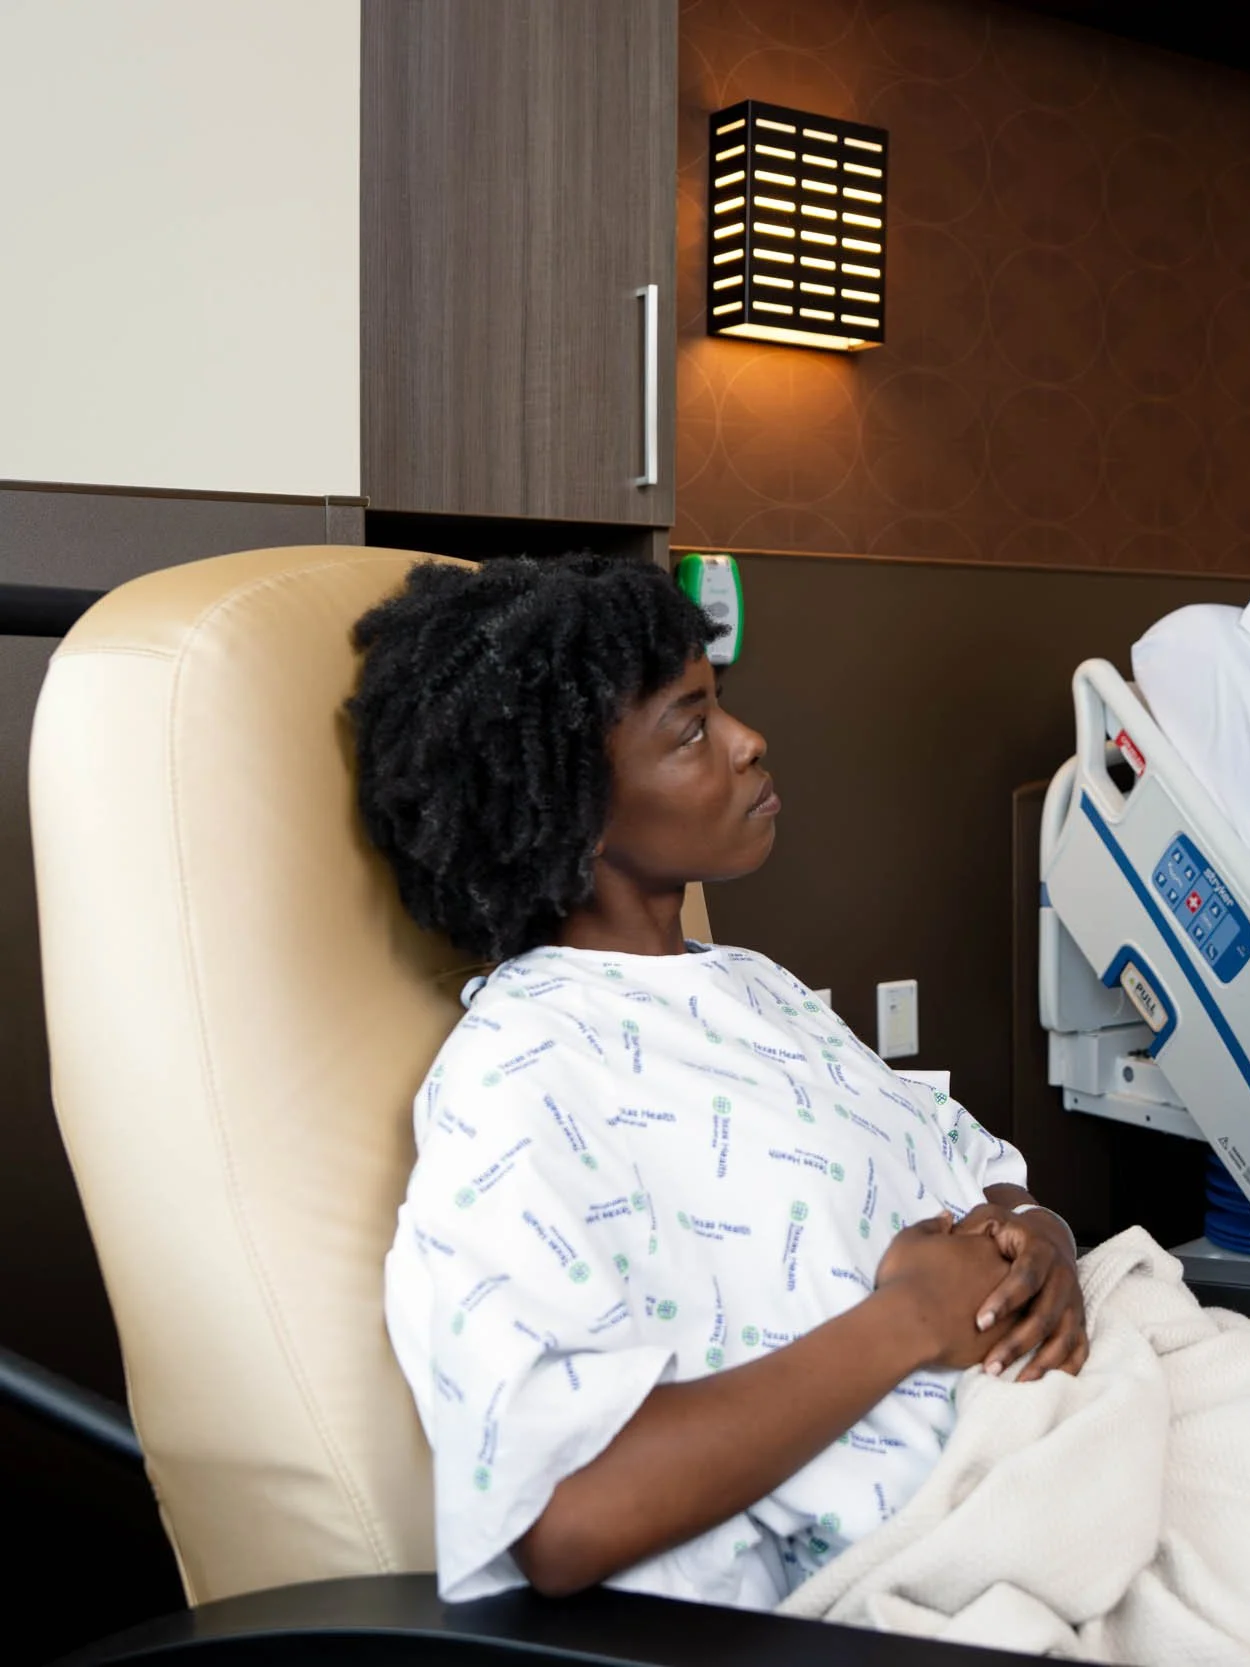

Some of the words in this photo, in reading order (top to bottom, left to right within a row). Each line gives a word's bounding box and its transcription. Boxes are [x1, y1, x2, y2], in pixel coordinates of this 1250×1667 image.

[1203, 867, 1234, 906] stryker
[1135, 982, 1156, 1012] PULL
[753, 1041, 777, 1056] Texas
[779, 1047, 808, 1062] Health
